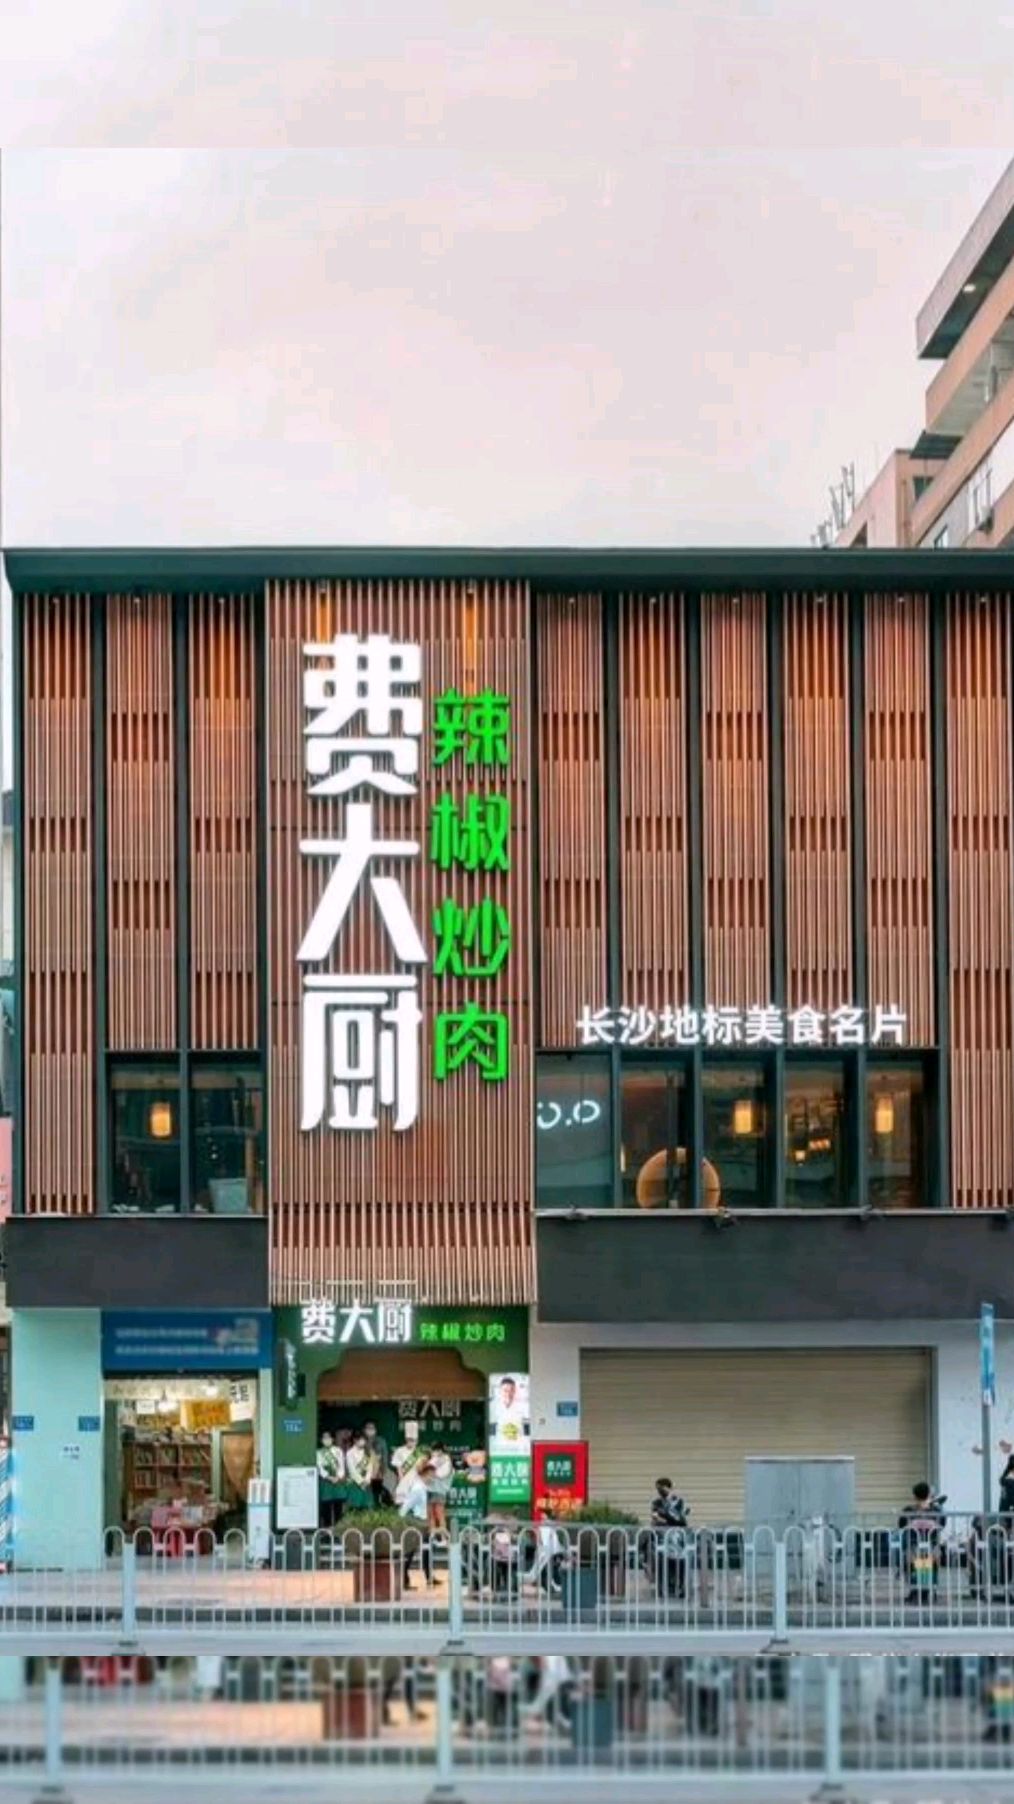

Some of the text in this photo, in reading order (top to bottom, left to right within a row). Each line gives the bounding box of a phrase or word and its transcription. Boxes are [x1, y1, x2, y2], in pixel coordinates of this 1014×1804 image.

[297, 634, 427, 1131] 费大厨
[431, 688, 511, 1081] 辣椒炒肉
[576, 1004, 907, 1044] 长沙地标美食名片
[301, 1299, 412, 1344] 费大厨
[420, 1323, 505, 1342] 辣椒炒肉
